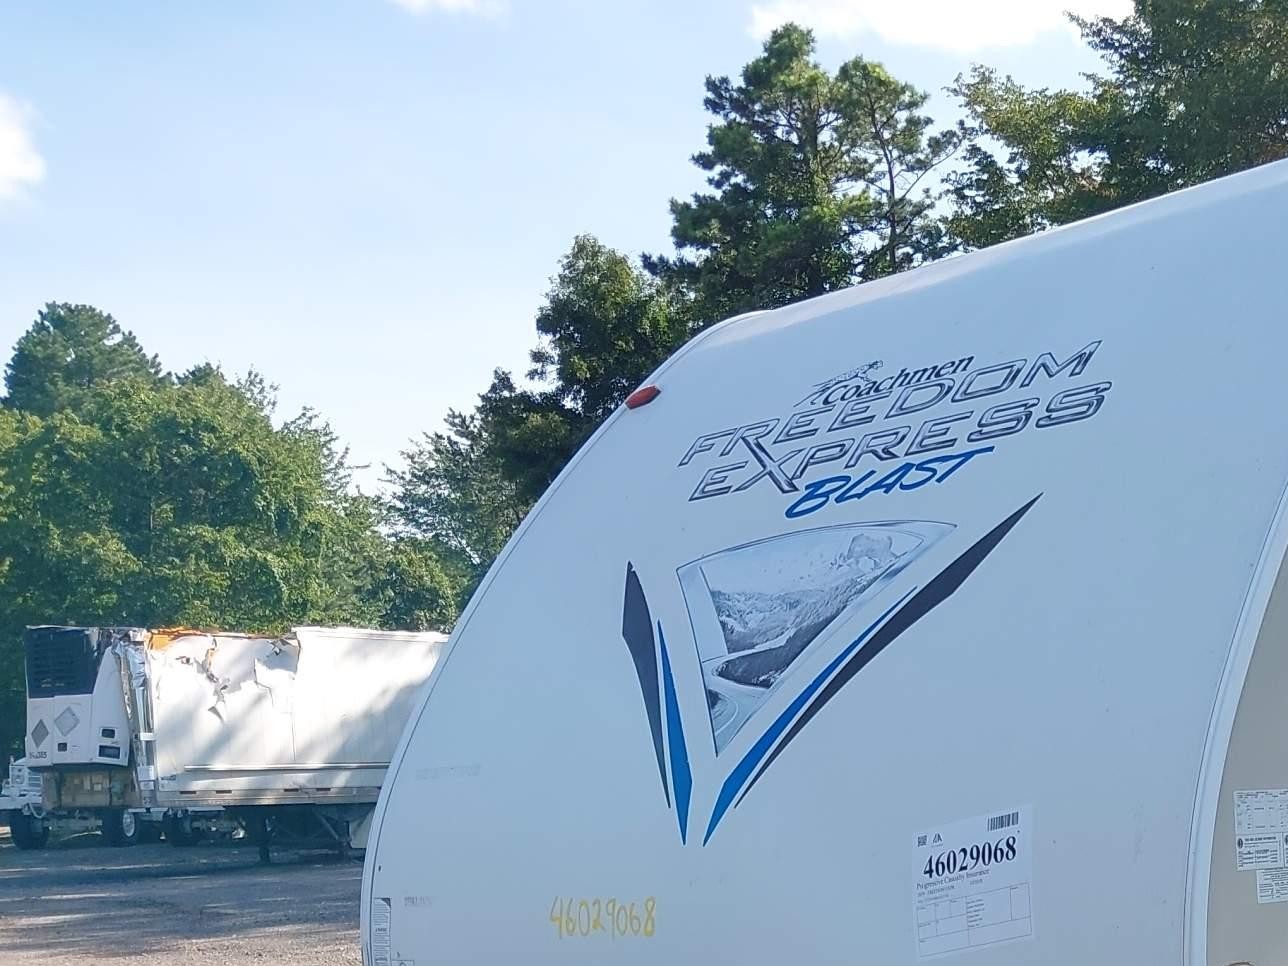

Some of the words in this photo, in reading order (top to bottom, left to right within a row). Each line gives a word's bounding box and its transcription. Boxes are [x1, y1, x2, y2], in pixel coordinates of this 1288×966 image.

[678, 340, 1102, 468] FREEDOM
[822, 356, 974, 406] Coachmen
[688, 381, 1112, 501] EXPRESS
[785, 446, 995, 519] BLAST
[923, 835, 1017, 879] 46029068
[549, 896, 657, 940] 46029068
